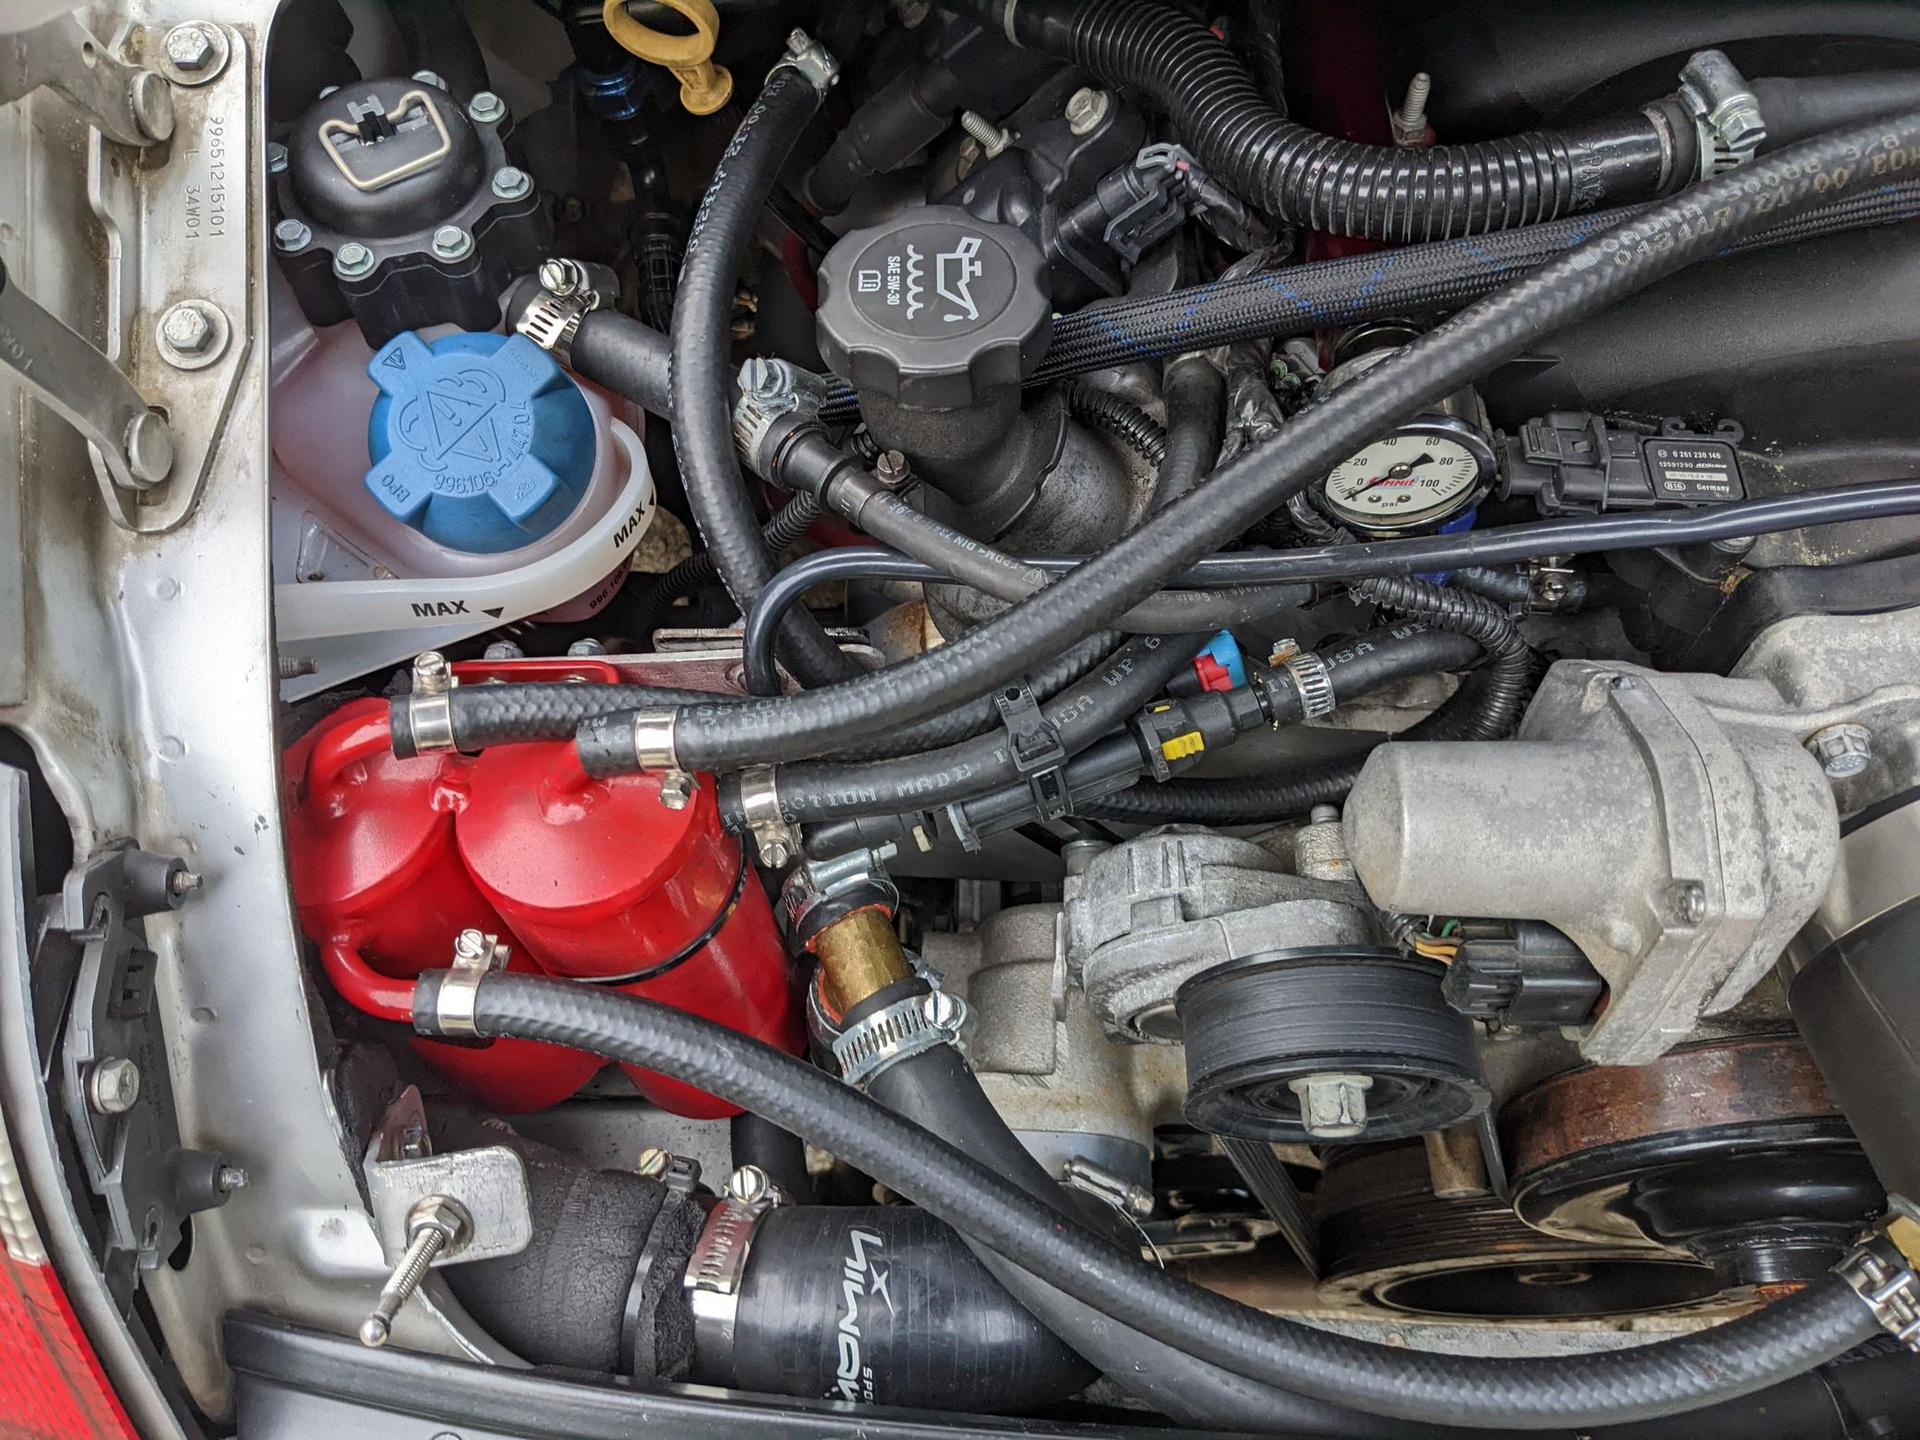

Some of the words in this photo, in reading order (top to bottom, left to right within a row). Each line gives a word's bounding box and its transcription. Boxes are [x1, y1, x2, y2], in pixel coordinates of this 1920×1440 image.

[208, 116, 224, 237] 99651215101
[184, 184, 200, 238] 34W01
[887, 255, 900, 274] SAE
[886, 275, 900, 305] 5W-30
[1425, 437, 1439, 446] 60
[1352, 456, 1367, 466] 20
[1438, 456, 1453, 466] 80
[1692, 450, 1707, 458] 230
[1356, 477, 1363, 485] 0
[1419, 478, 1439, 488] 100
[1696, 483, 1730, 492] Germany
[612, 501, 647, 548] MAX
[952, 536, 975, 552] DIN
[411, 599, 471, 618] MAX
[896, 762, 972, 797] MADE
